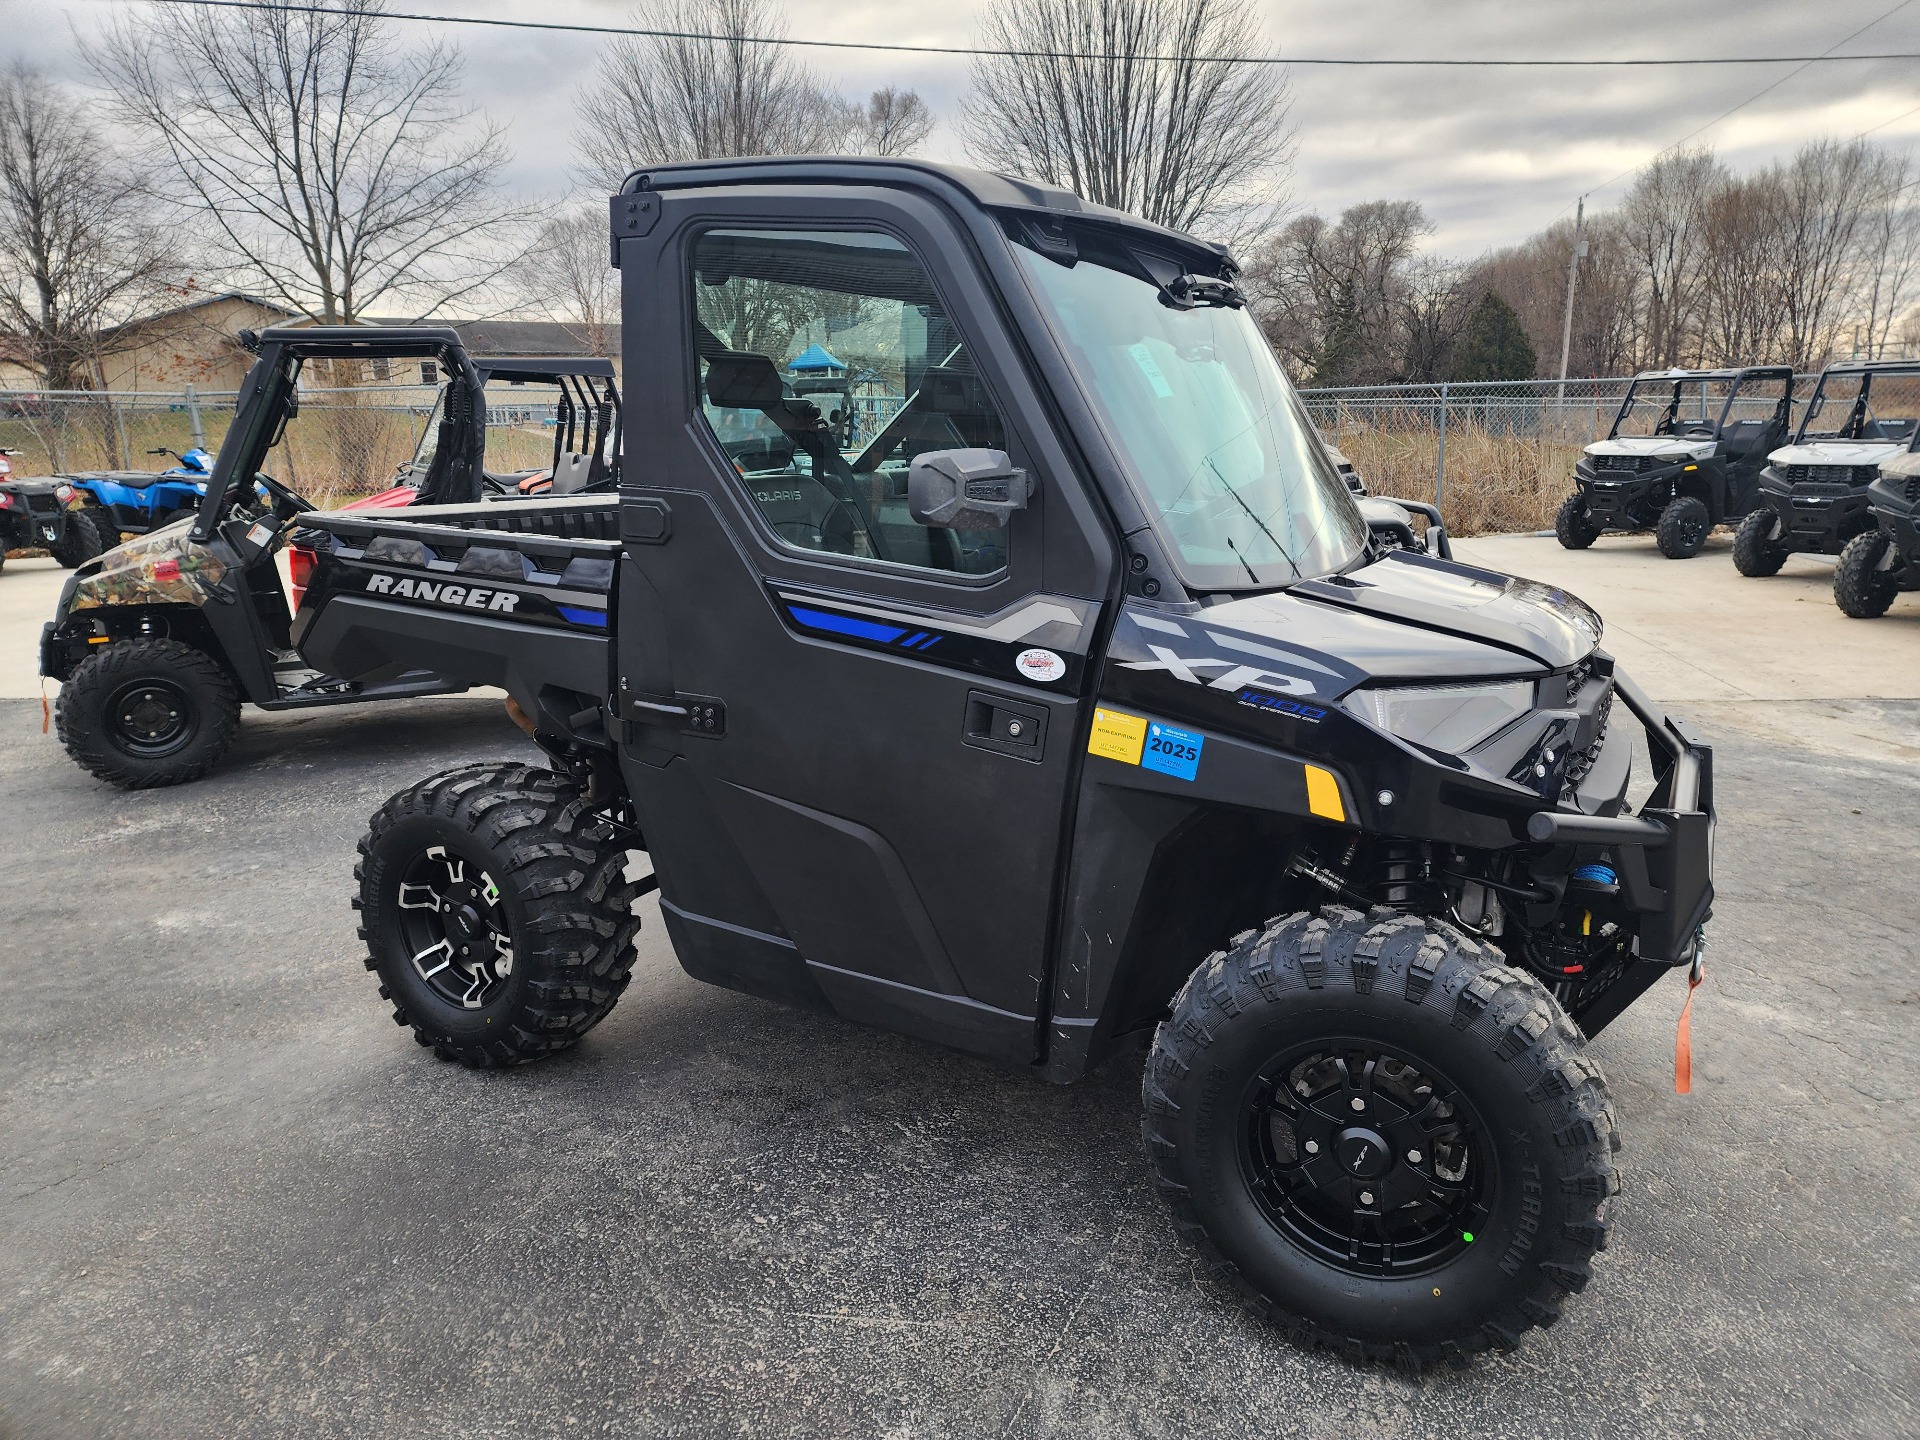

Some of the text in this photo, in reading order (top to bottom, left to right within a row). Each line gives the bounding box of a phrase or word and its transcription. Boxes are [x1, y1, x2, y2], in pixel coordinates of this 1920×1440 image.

[365, 574, 520, 613] RANGER
[1114, 644, 1317, 696] XP
[1240, 691, 1327, 719] 1000
[1150, 737, 1198, 761] 2025
[1498, 1126, 1543, 1278] X-TERRAIN
